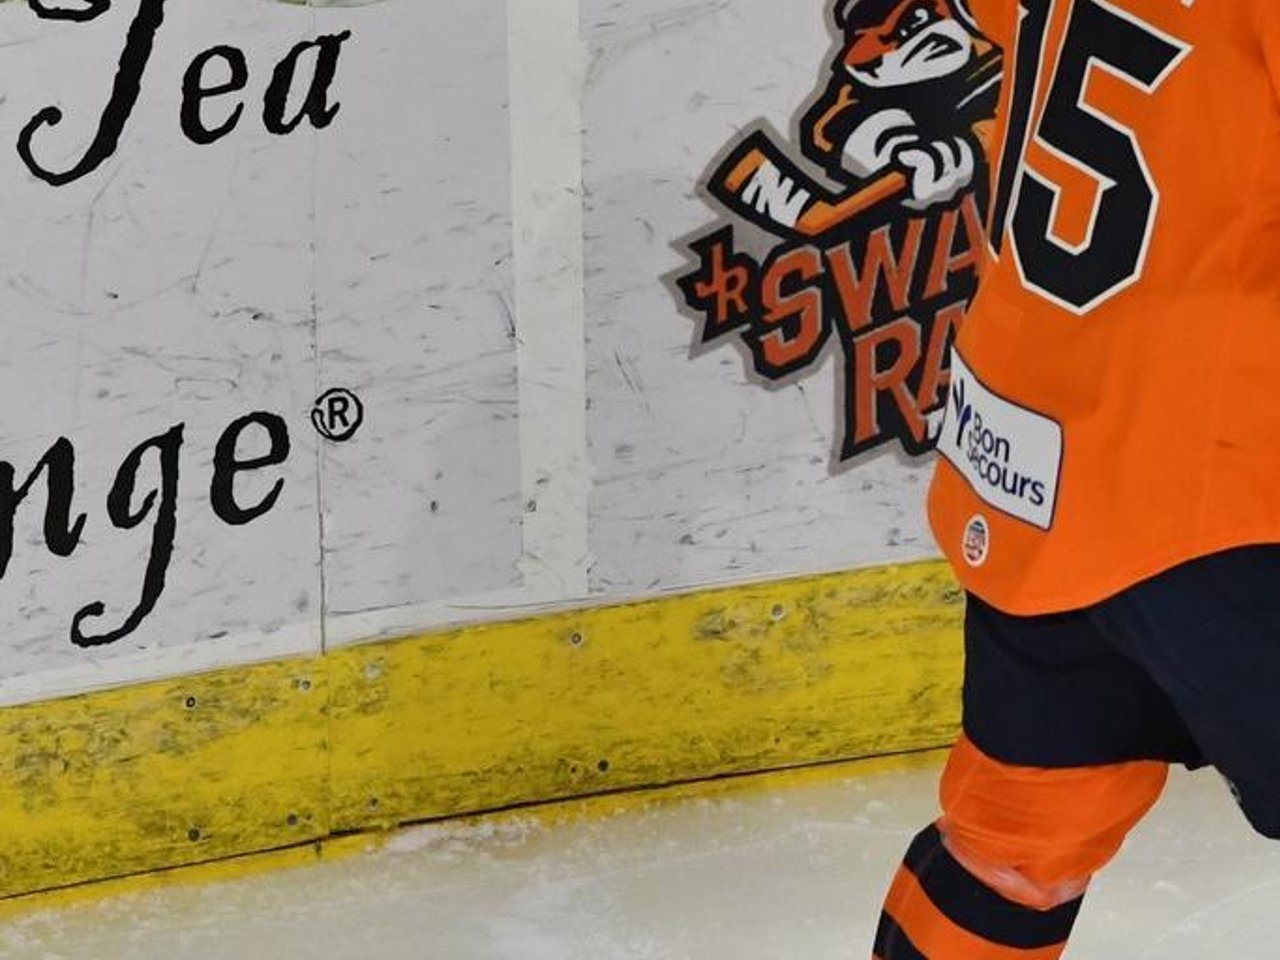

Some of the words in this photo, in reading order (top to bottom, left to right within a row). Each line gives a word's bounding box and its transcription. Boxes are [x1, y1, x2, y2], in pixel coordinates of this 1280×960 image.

[760, 193, 985, 367] SWA
[966, 436, 1046, 507] Secours
[969, 411, 1010, 464] Bon
